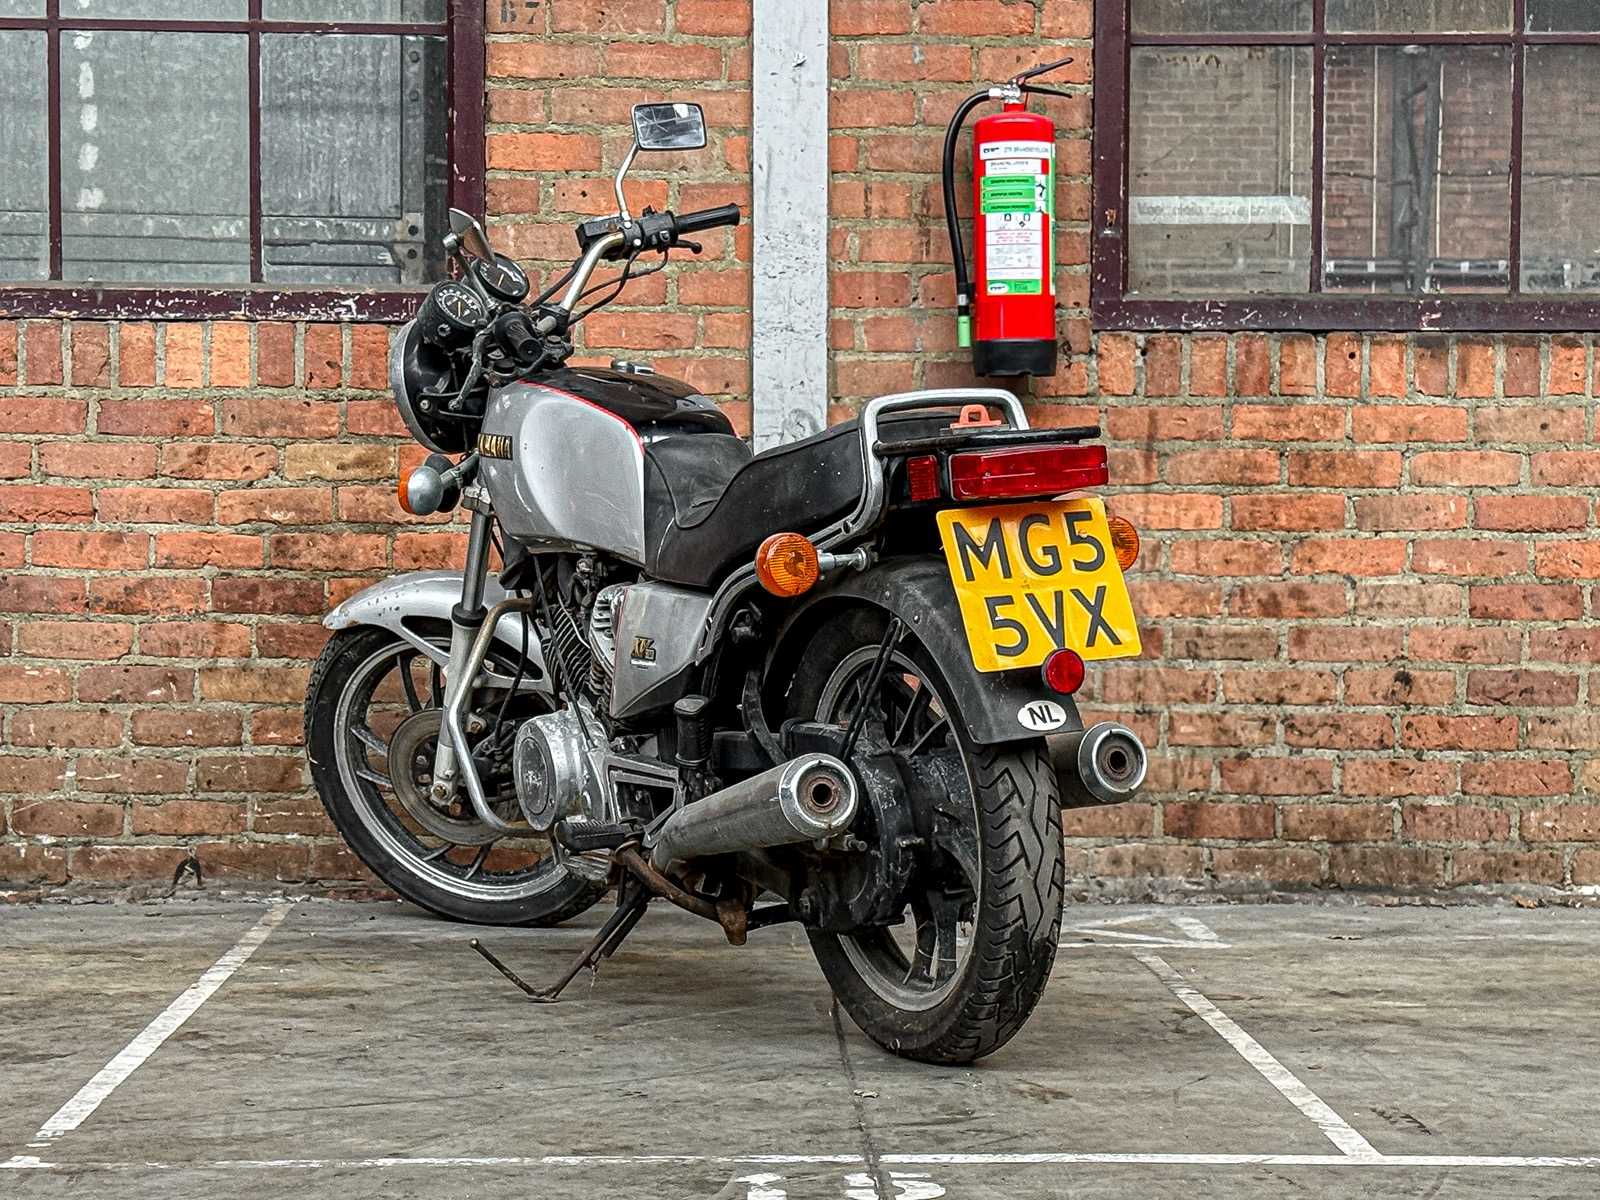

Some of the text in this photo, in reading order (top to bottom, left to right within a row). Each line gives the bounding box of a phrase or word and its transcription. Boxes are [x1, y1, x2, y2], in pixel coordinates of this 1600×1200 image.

[952, 510, 1106, 582] MG5
[984, 585, 1122, 657] 5VX
[1027, 706, 1061, 726] NL
